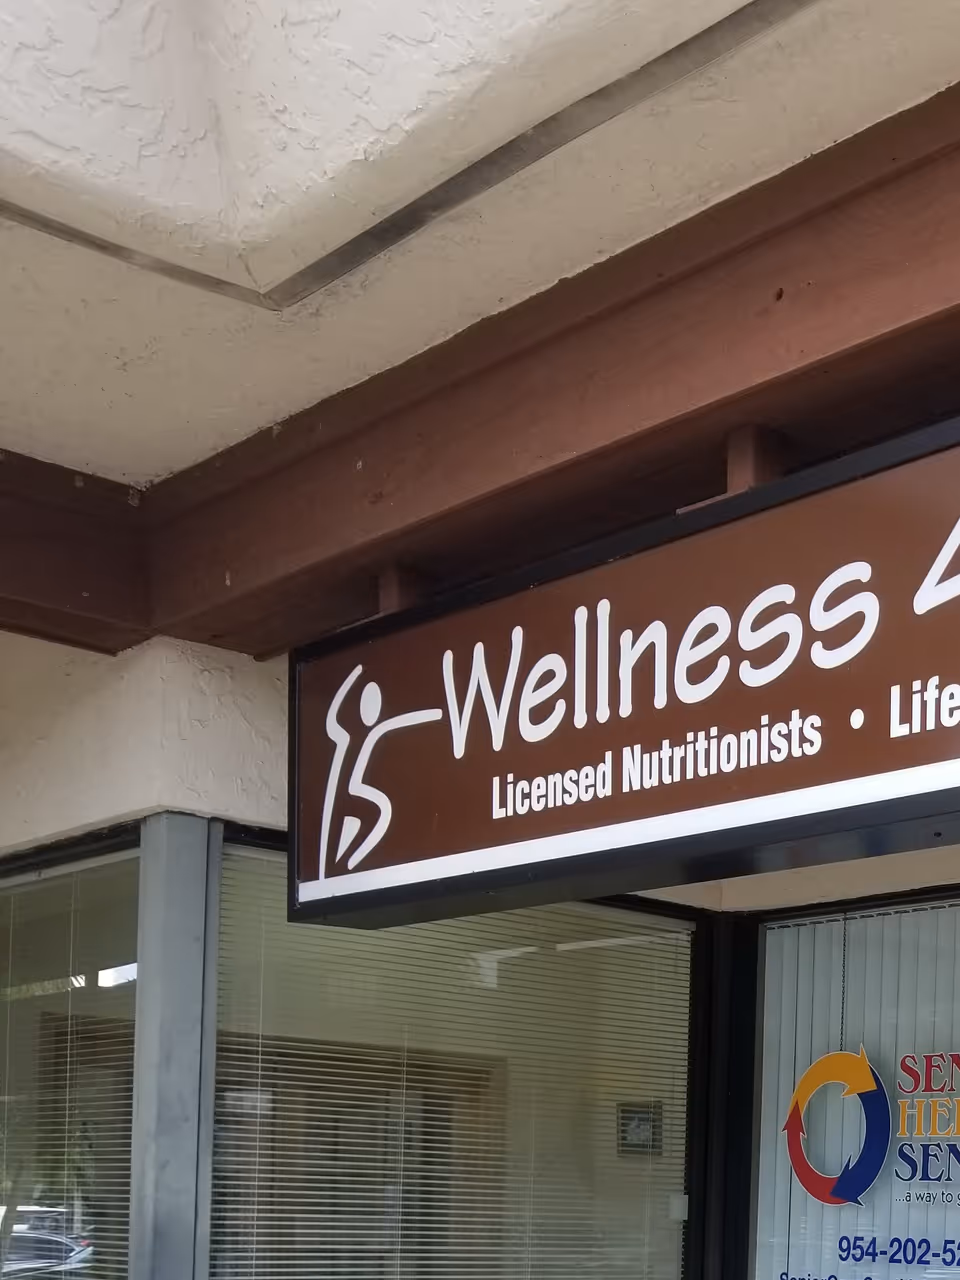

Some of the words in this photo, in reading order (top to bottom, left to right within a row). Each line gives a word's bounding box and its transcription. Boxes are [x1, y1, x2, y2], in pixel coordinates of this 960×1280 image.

[442, 561, 880, 759] Wellness
[492, 749, 613, 820] Licensed
[622, 707, 822, 793] Nutritionists
[915, 1193, 938, 1208] way
[941, 1191, 954, 1205] to
